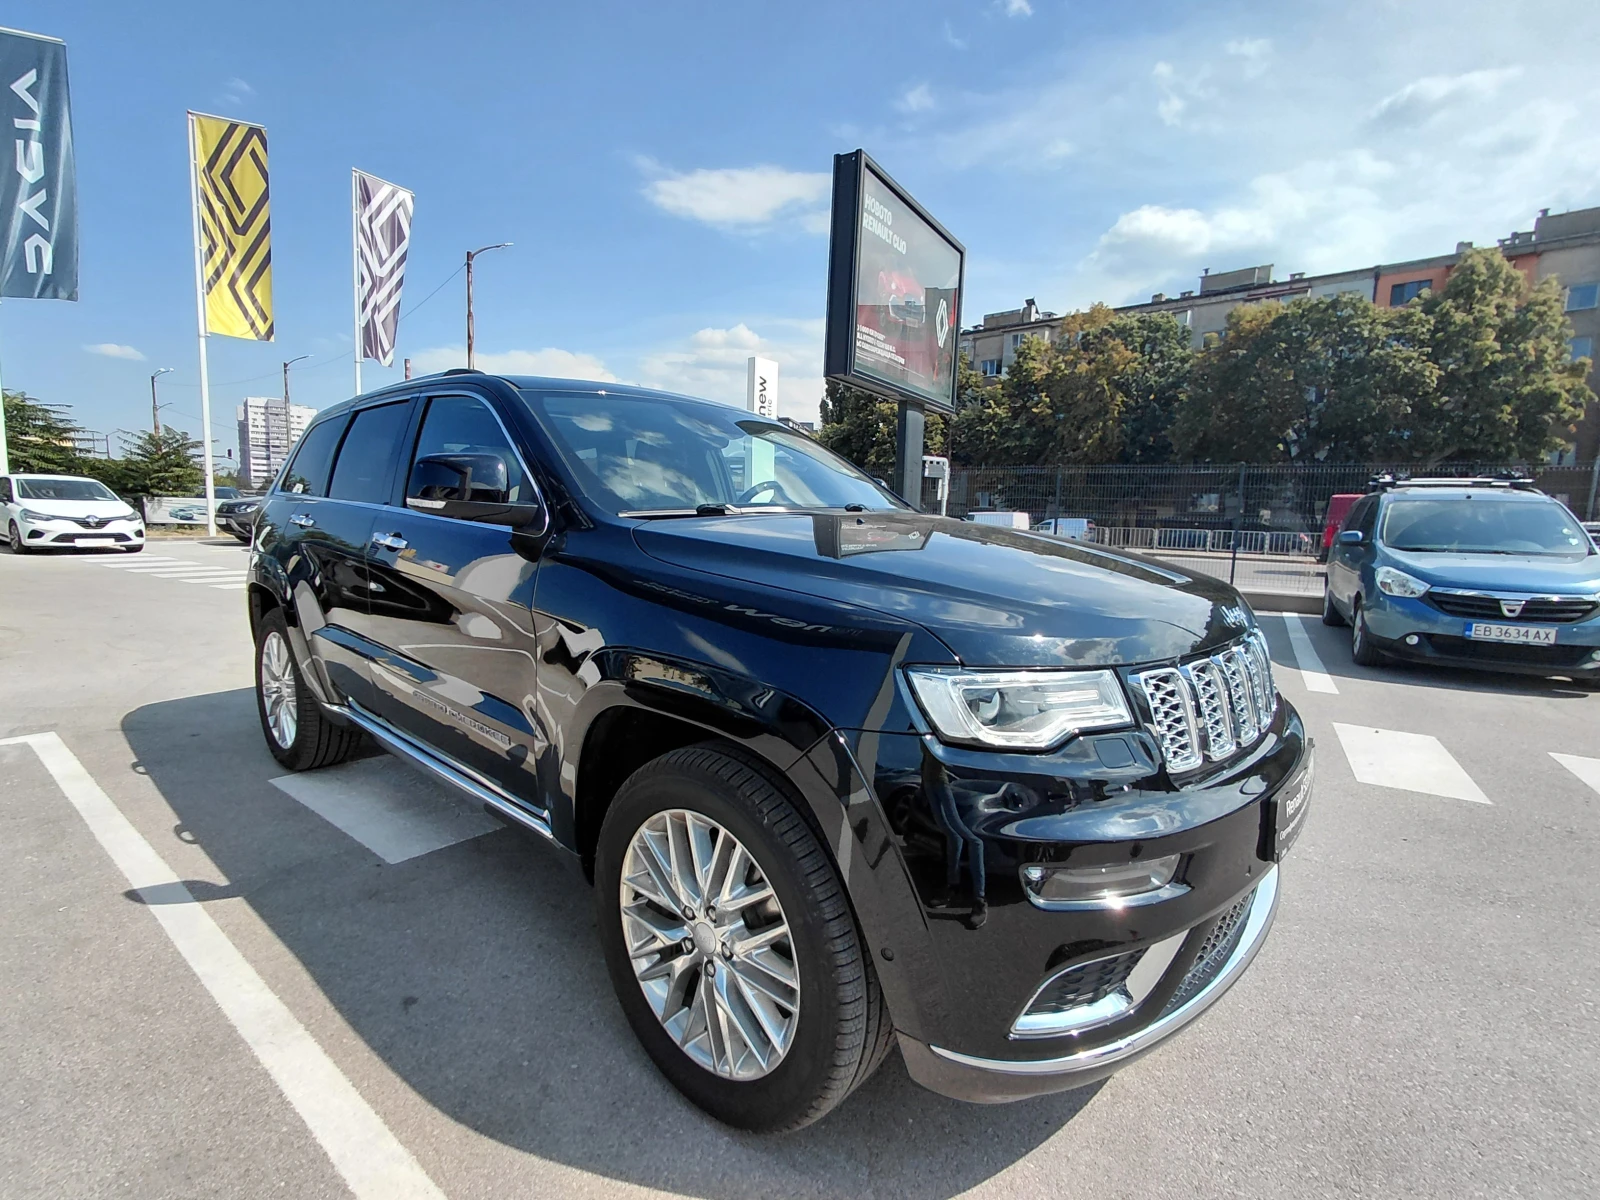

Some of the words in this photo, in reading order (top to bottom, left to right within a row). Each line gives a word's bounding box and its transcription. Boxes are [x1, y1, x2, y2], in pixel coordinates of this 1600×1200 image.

[9, 68, 53, 274] DACIA
[865, 194, 892, 226] НОВОТО
[863, 212, 893, 245] RENAULT
[893, 234, 907, 255] CLIO
[1473, 625, 1492, 637] EB
[1495, 627, 1529, 639] 3634
[1533, 630, 1551, 641] AX
